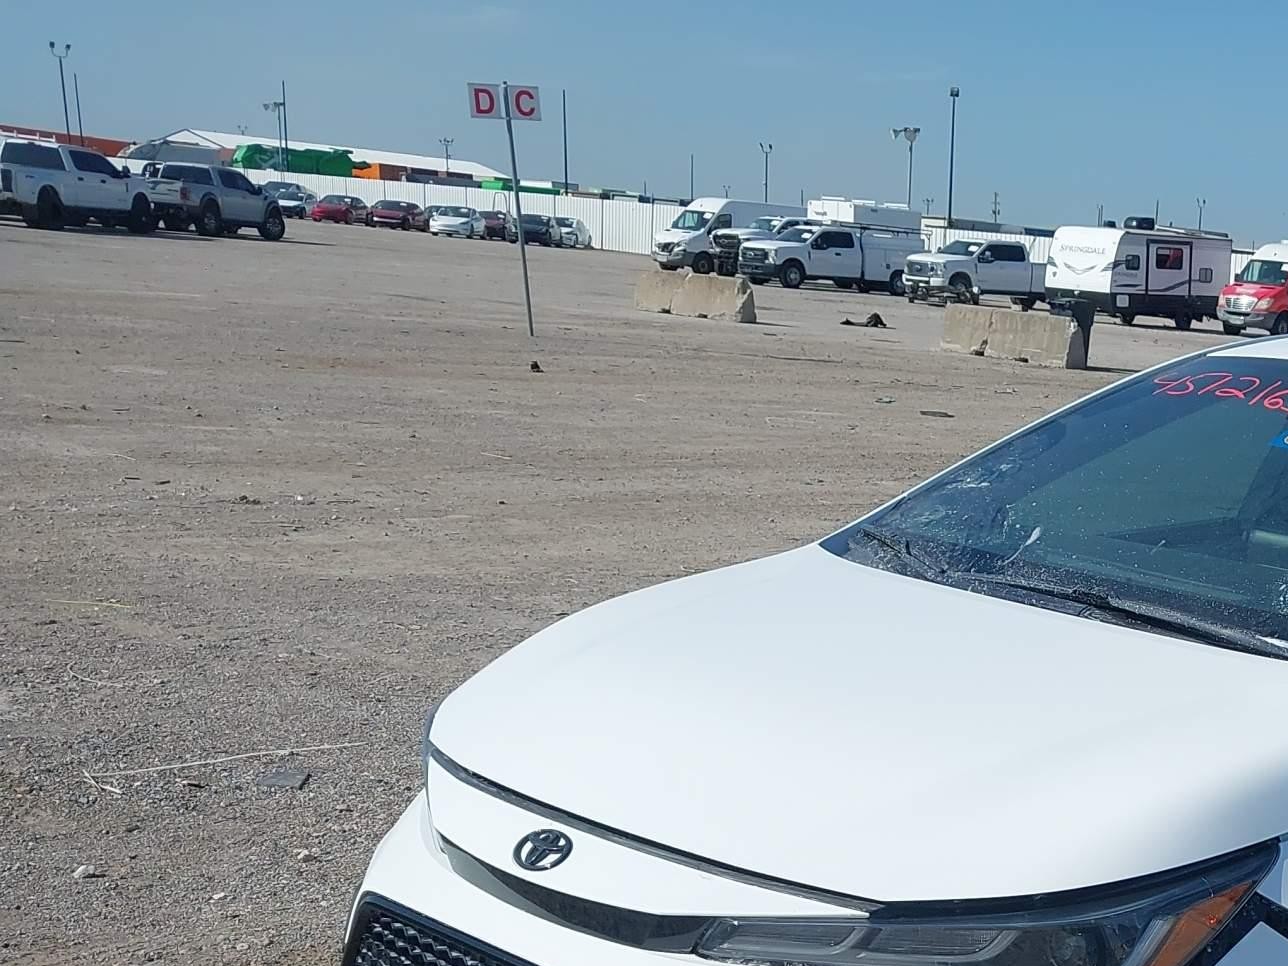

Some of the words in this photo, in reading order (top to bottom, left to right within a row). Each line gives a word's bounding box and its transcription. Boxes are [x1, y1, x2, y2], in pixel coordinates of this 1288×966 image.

[474, 88, 495, 114] D
[515, 89, 535, 117] C
[1059, 244, 1106, 255] SPRINGDALE
